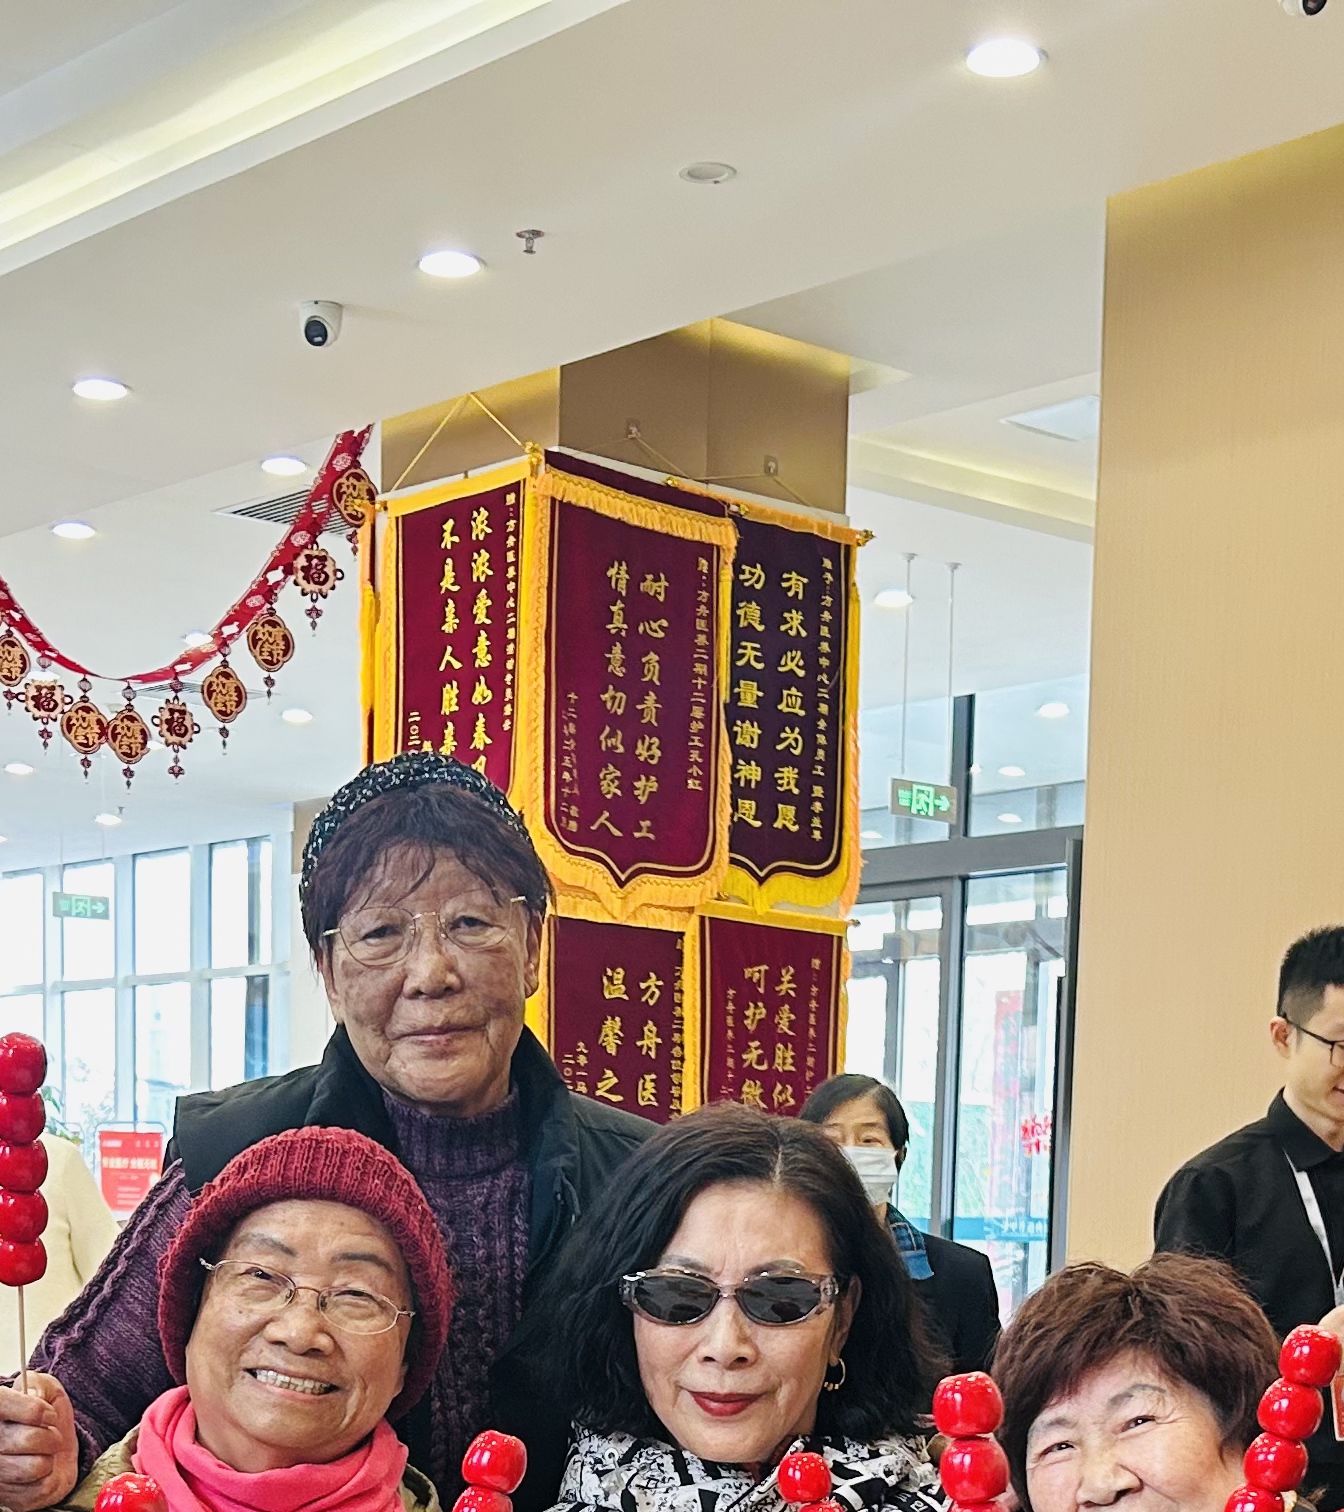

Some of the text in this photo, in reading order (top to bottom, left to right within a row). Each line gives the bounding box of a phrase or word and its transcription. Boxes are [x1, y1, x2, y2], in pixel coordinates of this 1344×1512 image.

[590, 561, 630, 838] 情真意切似家人
[633, 571, 669, 841] 耐心负责好护工
[733, 563, 767, 830] 功德无量谢神恩
[772, 571, 809, 832] 有求必应为我愿
[595, 967, 630, 1103] 温馨之
[636, 971, 664, 1107] 方舟医
[772, 964, 797, 1109] 关爱胜似
